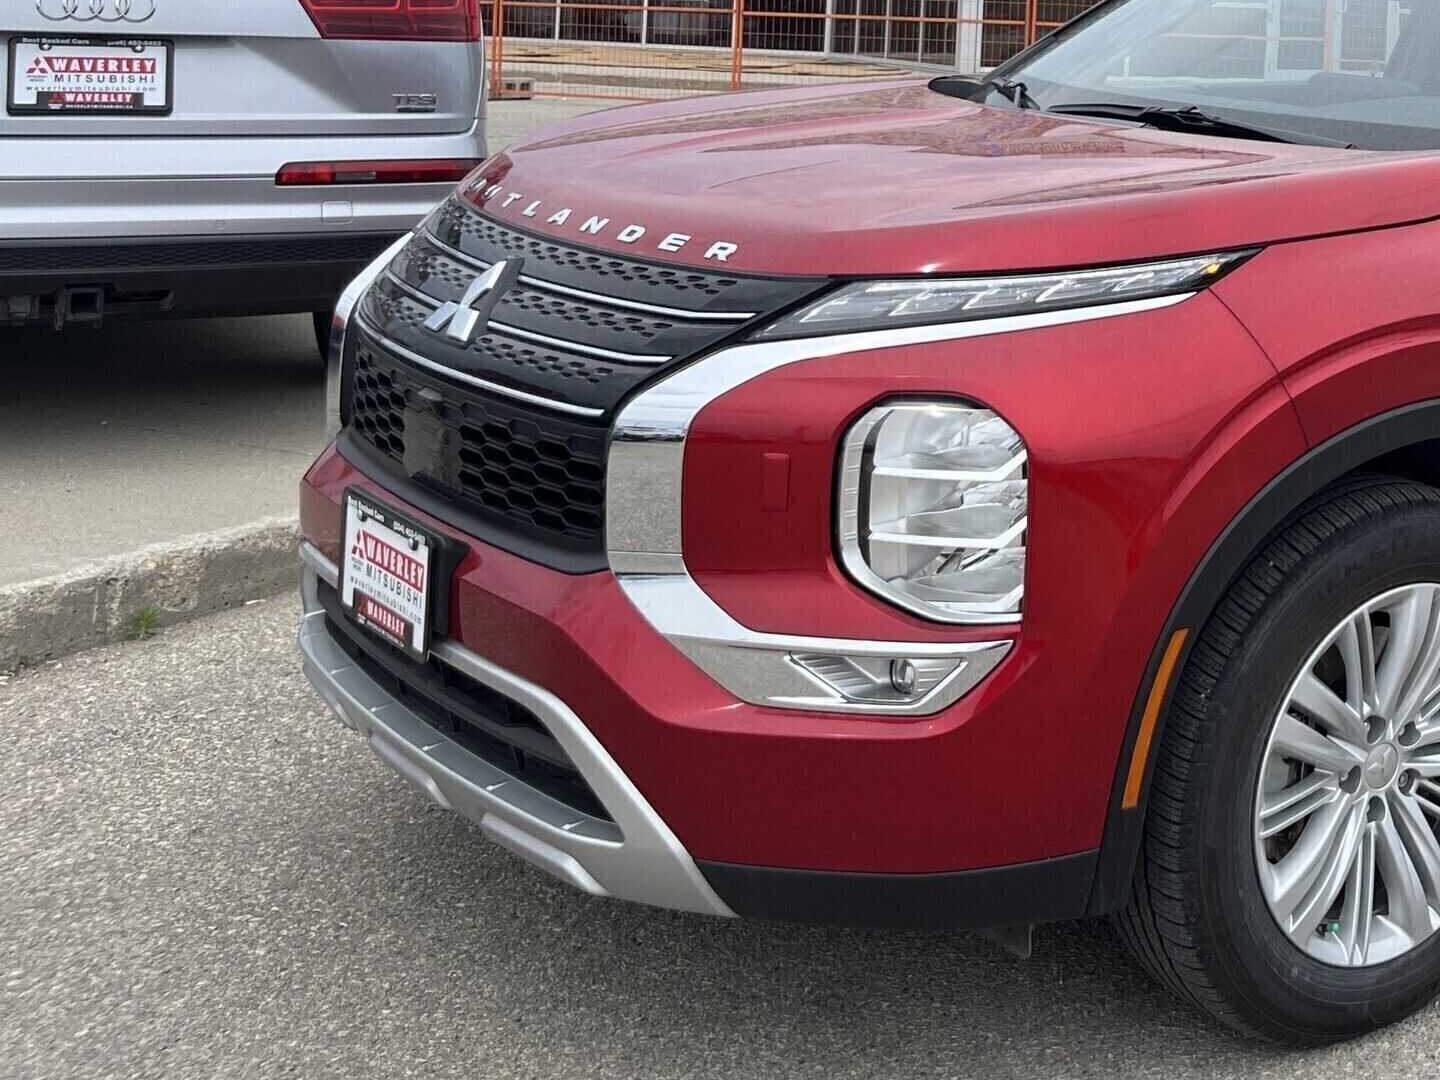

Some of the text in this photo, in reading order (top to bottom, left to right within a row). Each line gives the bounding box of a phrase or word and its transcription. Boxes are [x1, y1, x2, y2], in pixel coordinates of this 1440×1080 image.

[42, 37, 71, 45] Backed
[52, 58, 155, 72] WAVERLEY
[54, 74, 155, 83] MITSUBISHI
[65, 93, 133, 103] WAVERLEY
[392, 93, 437, 105] TFSI
[467, 177, 739, 262] OUTLANDER
[366, 536, 424, 588] WAVERLEY
[366, 563, 423, 609] MITSUBISHI
[350, 575, 422, 625] waverleymitsubishi.com
[367, 600, 405, 636] WAVERLEY
